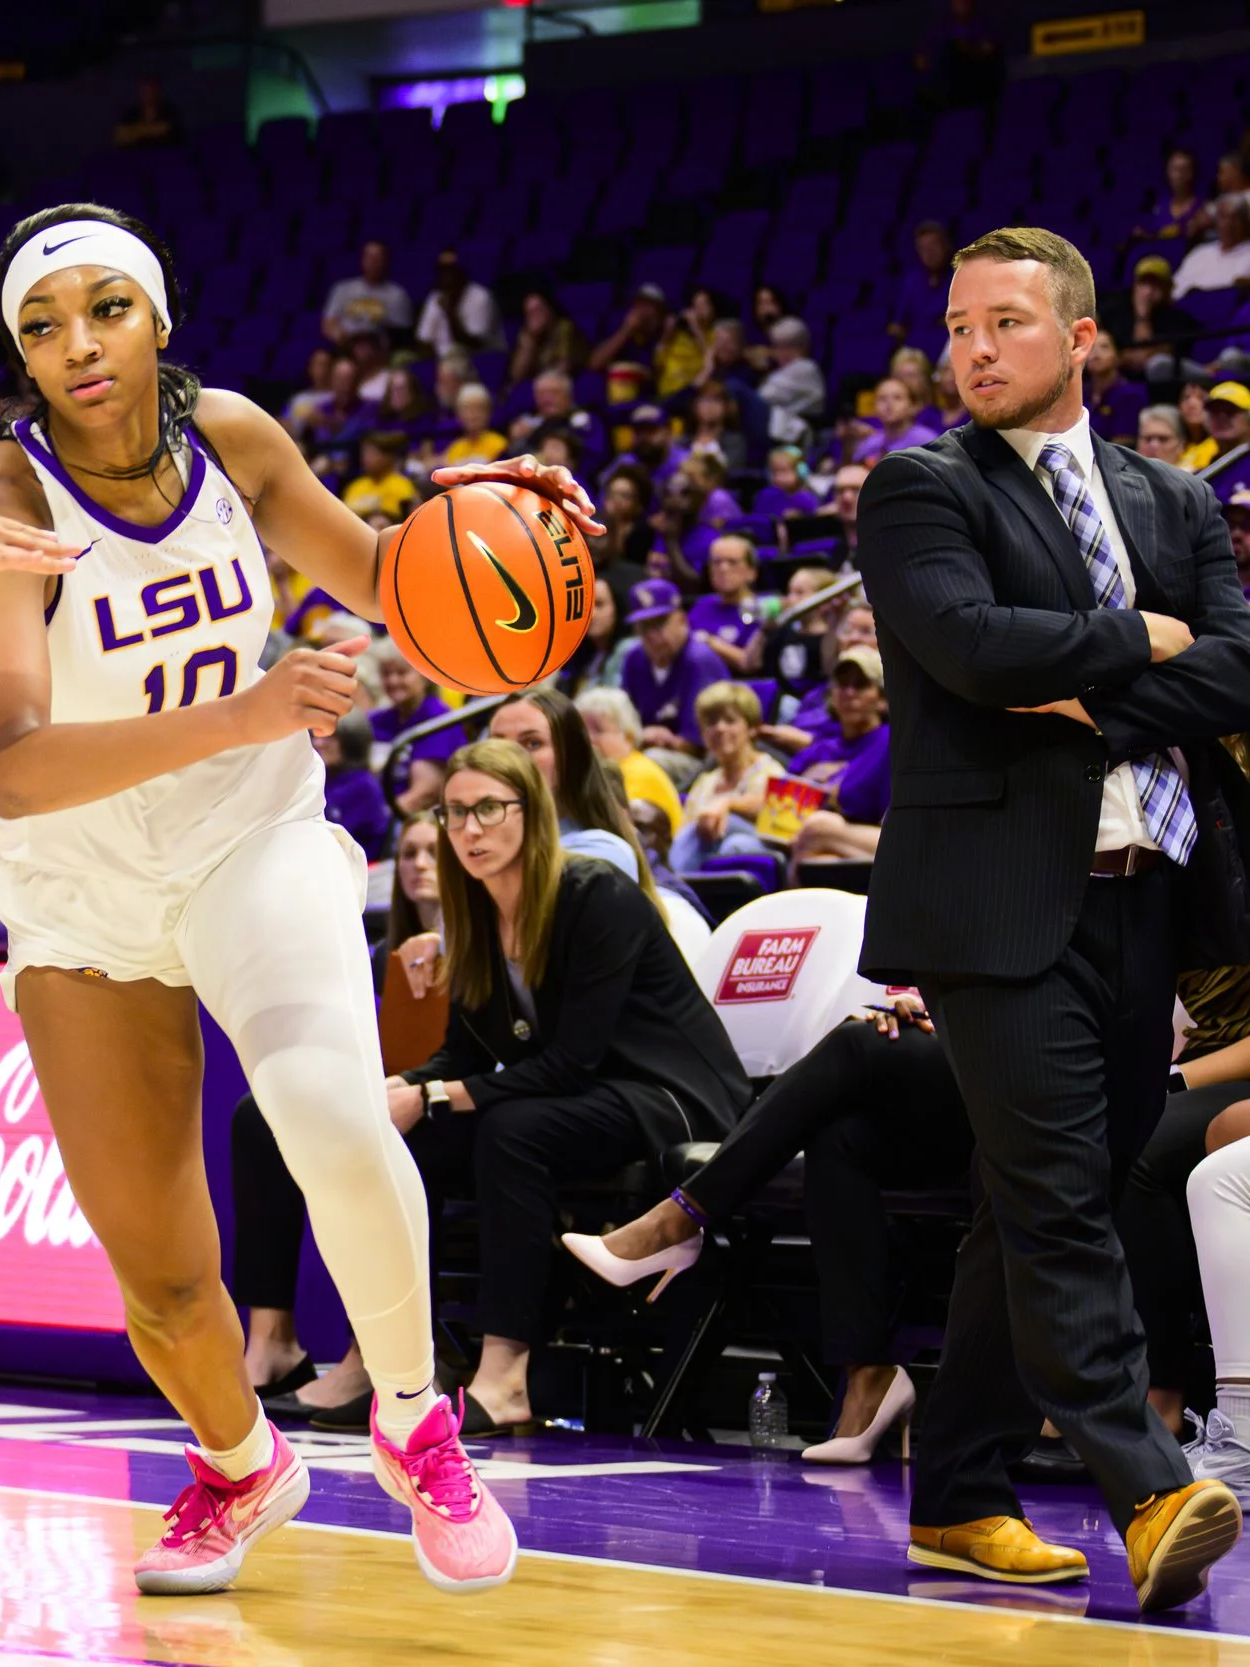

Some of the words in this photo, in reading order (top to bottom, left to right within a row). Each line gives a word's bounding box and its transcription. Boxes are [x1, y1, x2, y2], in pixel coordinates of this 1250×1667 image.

[535, 509, 584, 622] ELITE
[92, 557, 253, 652] LSU
[143, 643, 238, 715] 10
[731, 955, 800, 976] BUREAU
[757, 937, 806, 955] FARM
